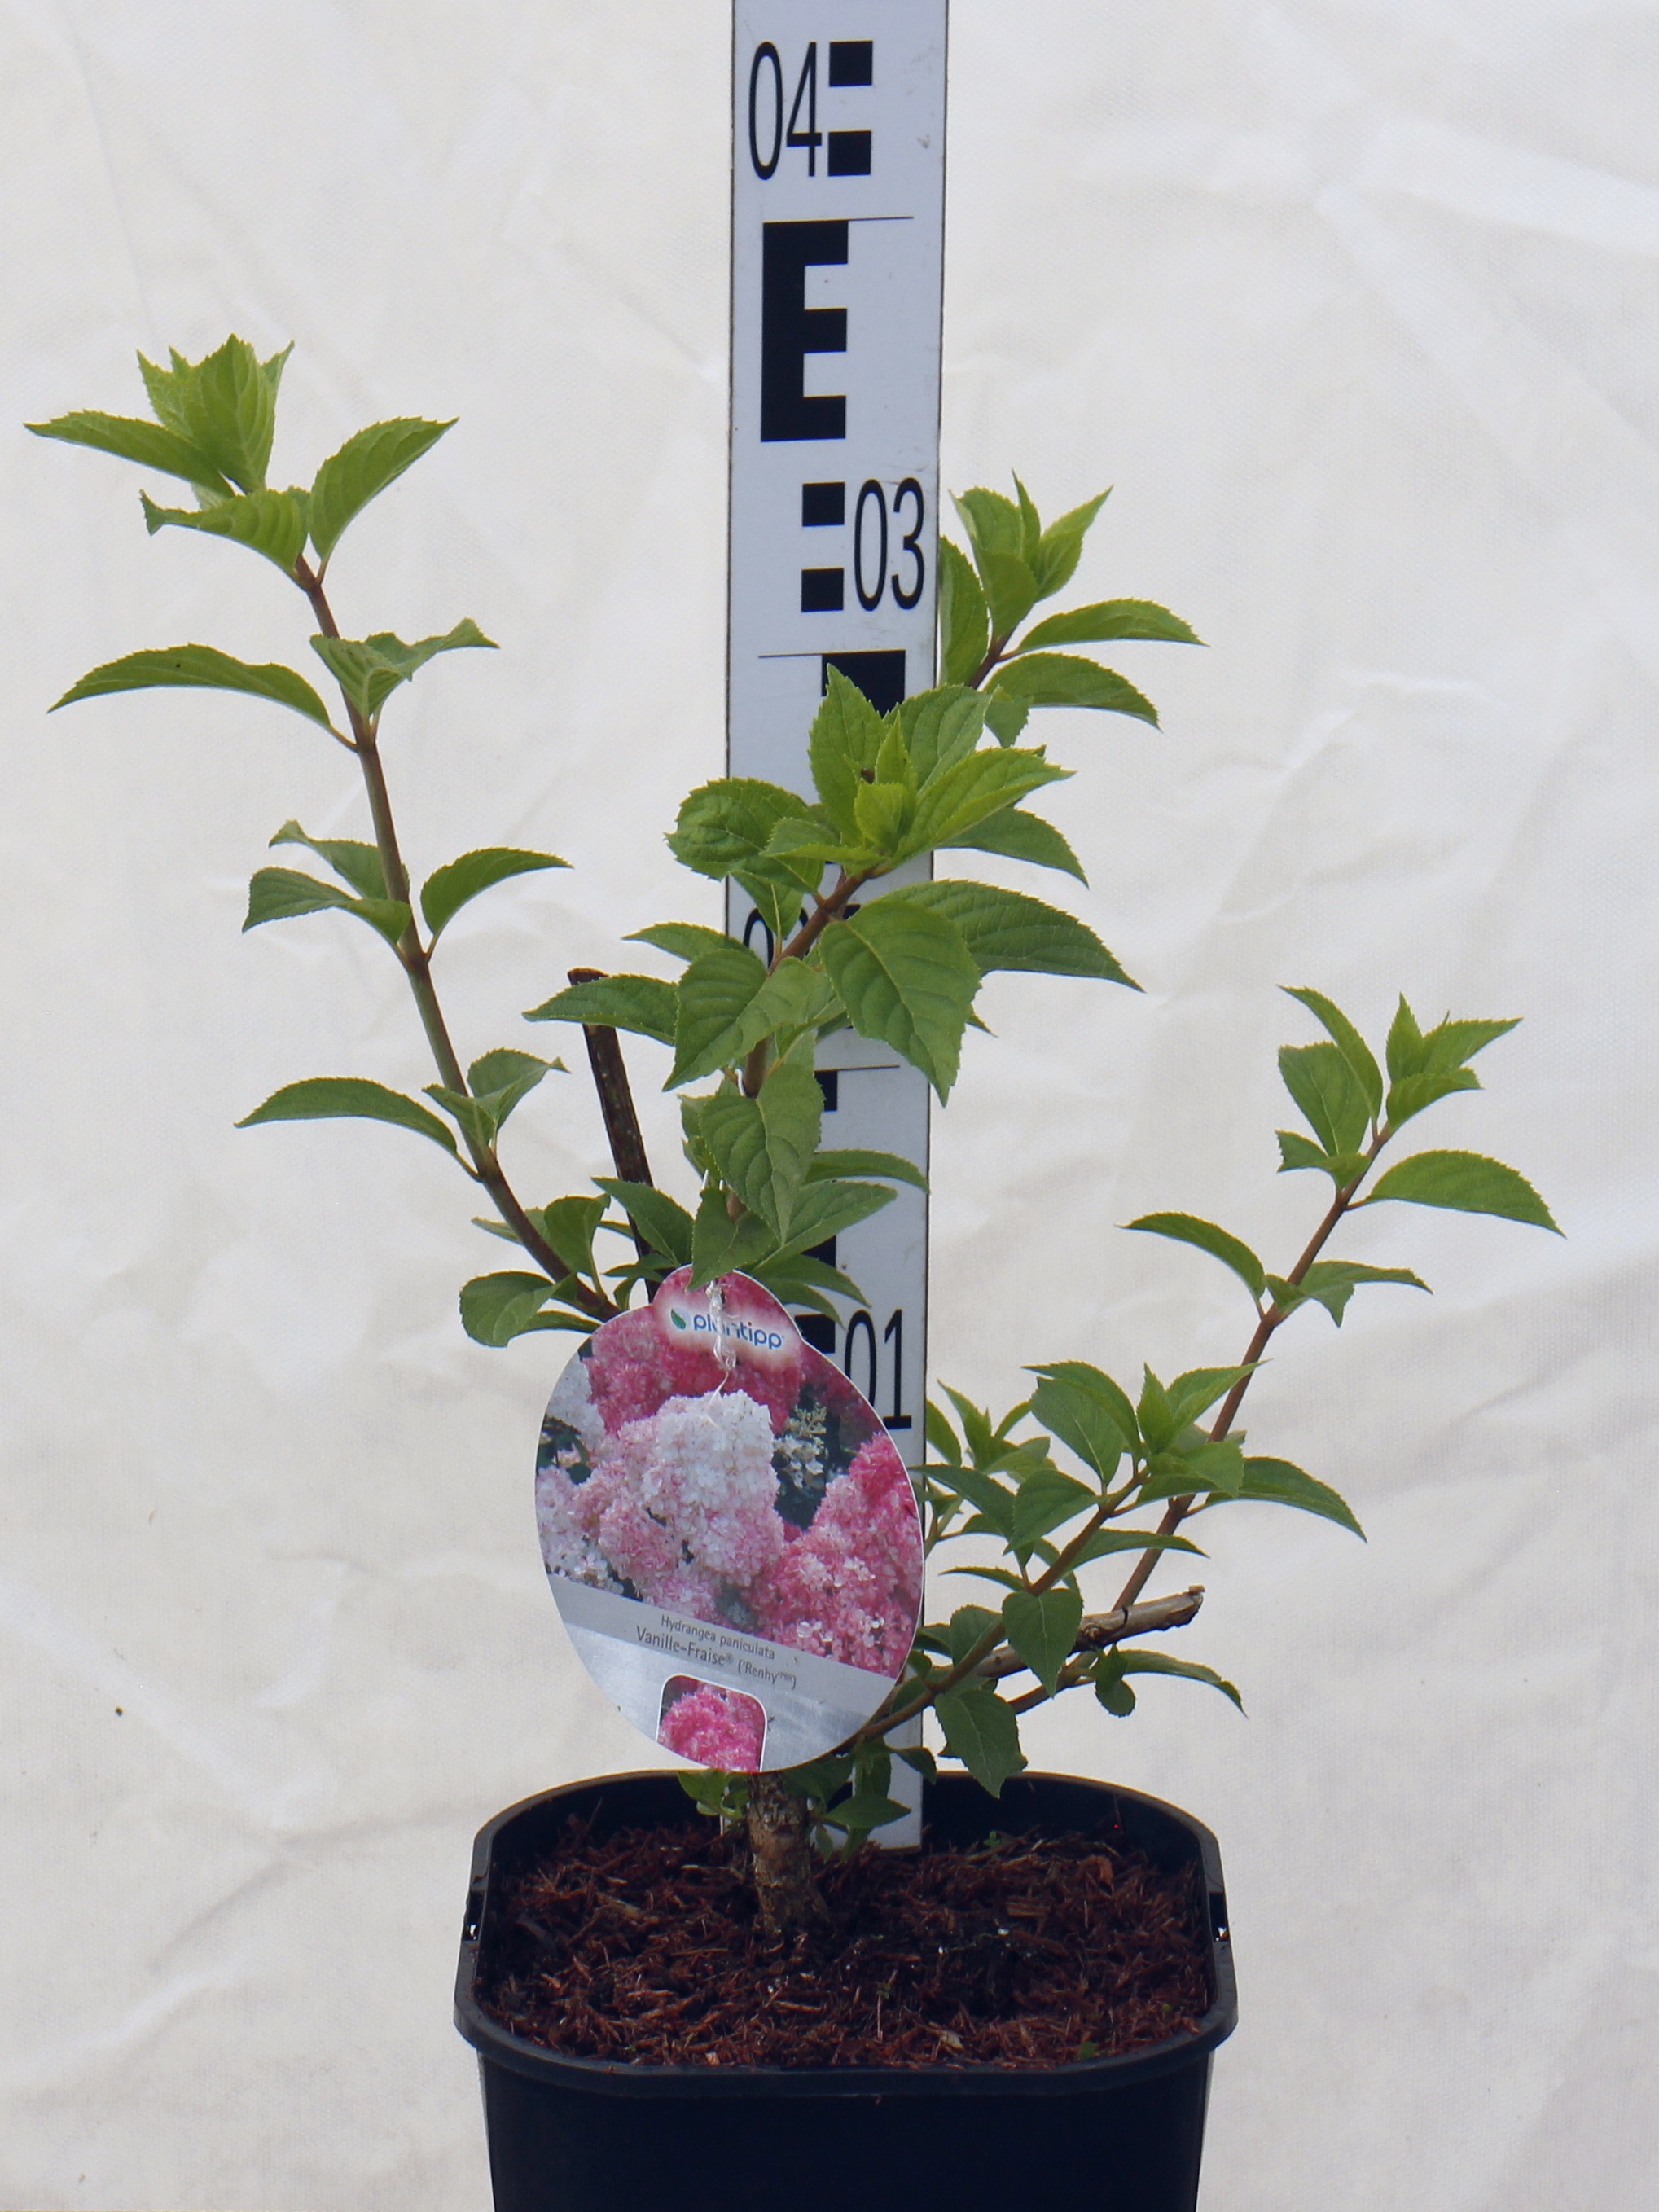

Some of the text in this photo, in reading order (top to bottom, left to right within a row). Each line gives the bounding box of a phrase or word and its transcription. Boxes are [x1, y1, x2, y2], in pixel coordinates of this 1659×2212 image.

[748, 42, 821, 180] 04
[854, 478, 924, 611] 03
[845, 1309, 911, 1429] 01
[661, 1614, 775, 1659] Hydrangea paniculata
